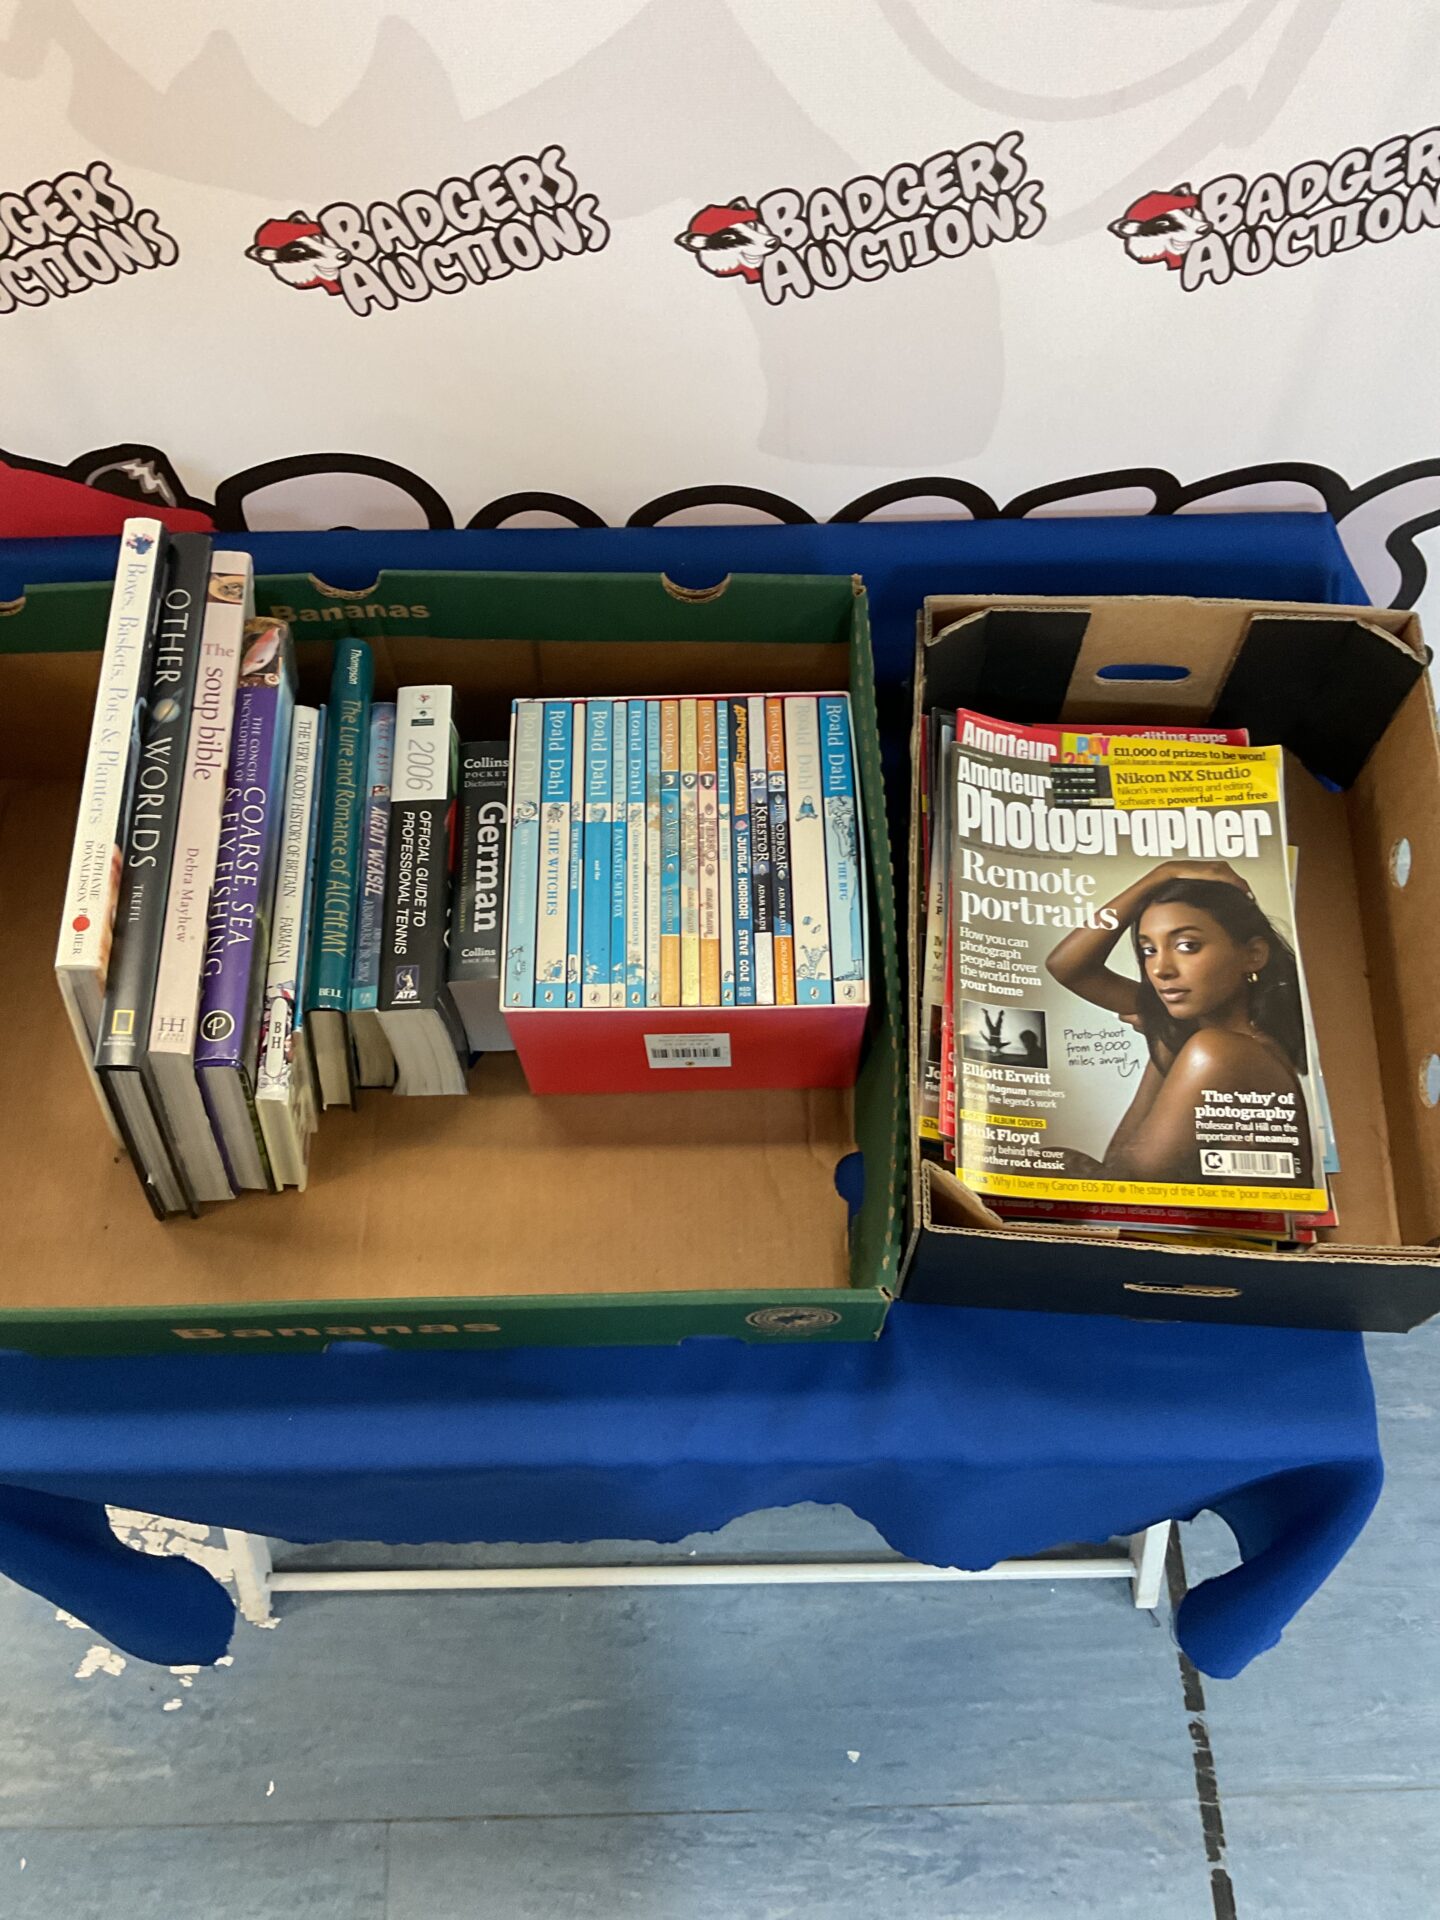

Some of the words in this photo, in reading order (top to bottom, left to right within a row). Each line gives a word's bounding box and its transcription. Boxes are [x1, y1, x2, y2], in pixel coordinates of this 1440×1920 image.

[757, 131, 1027, 249] BADGERS
[1199, 126, 1440, 236] BADGER
[0, 161, 133, 252] GERS
[319, 145, 577, 262] BADGERS
[760, 180, 1046, 305] AUCTIONS
[1181, 181, 1440, 292] AUCTION
[0, 209, 178, 313] CTIONS
[339, 194, 609, 316] AUCTIONS
[118, 563, 147, 610] Boxes,
[270, 603, 431, 622] Bananas
[154, 589, 191, 686] OTHER
[203, 643, 235, 658] The
[347, 649, 362, 685] Thompson
[194, 667, 223, 720] soup
[342, 700, 361, 723] The
[235, 694, 253, 767] ENCYCLOPEDIA
[252, 717, 263, 734] THE
[299, 721, 311, 739] THE
[339, 725, 359, 755] Lure
[549, 711, 566, 751] Roald
[591, 711, 608, 752] Roald
[631, 711, 641, 751] Roald
[798, 705, 811, 746] Roald
[826, 704, 844, 747] Roald
[962, 721, 1057, 762] Amateur
[192, 727, 225, 780] bible
[246, 739, 260, 781] CONCISE
[296, 742, 310, 764] VERY
[405, 739, 435, 791] 2006
[464, 757, 509, 769] Collins
[1114, 747, 1157, 758] £11,000
[1159, 747, 1171, 758] of
[1172, 748, 1208, 760] prizes
[1209, 749, 1220, 758] to
[1221, 749, 1235, 760] be
[1237, 751, 1266, 761] won!
[90, 750, 119, 824] Planters
[292, 766, 308, 803] BLOODY
[336, 759, 356, 787] and
[464, 780, 507, 788] Dictionary
[548, 760, 564, 795] Dahl
[590, 760, 607, 796] Dahl
[631, 760, 641, 795] Dahl
[665, 775, 674, 785] 3
[685, 775, 694, 786] 9
[704, 774, 711, 785] 1
[750, 772, 766, 782] 39
[769, 776, 784, 786] 48
[798, 754, 813, 790] Dahl
[828, 754, 846, 791] Dahl
[958, 756, 1054, 797] Amateur
[1116, 771, 1166, 785] Nikon
[1169, 771, 1192, 783] NX
[1196, 767, 1251, 782] Studio
[1150, 786, 1167, 794] new
[1168, 783, 1203, 795] viewing
[1205, 782, 1221, 792] and
[1223, 780, 1253, 793] editing
[129, 737, 173, 868] WORLDS
[224, 788, 242, 801] &
[1119, 796, 1156, 806] software
[1167, 793, 1213, 806] powerful
[1225, 793, 1243, 802] and
[1246, 790, 1268, 800] free
[220, 813, 239, 851] FLY
[289, 804, 304, 844] HISTORY
[331, 790, 355, 855] Romance
[369, 806, 387, 846] AGENT
[957, 781, 1272, 858] Photographer
[233, 787, 266, 891] COARSE,
[287, 846, 300, 857] OF
[417, 811, 432, 865] OFFICIAL
[549, 829, 560, 857] THE
[614, 829, 623, 881] FANTASTIC
[737, 837, 748, 873] JUNGLE
[183, 848, 199, 884] Debra
[330, 858, 350, 876] of
[365, 849, 385, 897] WEASEL
[397, 812, 415, 905] PROFESSIONAL
[474, 801, 507, 932] German
[960, 848, 1096, 896] Remote
[284, 858, 299, 897] BRITAIN
[414, 868, 429, 907] GUIDE
[546, 859, 558, 916] WITCHES
[175, 890, 194, 943] Mayhew
[738, 878, 749, 919] HORROR!
[960, 891, 1119, 931] portraits
[204, 862, 233, 976] FISHING
[227, 901, 254, 946] SEA
[320, 880, 350, 958] ALCHEMY
[394, 909, 409, 954] TENNIS
[413, 909, 426, 927] TO
[279, 917, 293, 958] FARMAN
[461, 949, 496, 957] Collins
[738, 930, 748, 956] STEVE
[960, 926, 984, 941] How
[985, 932, 1006, 945] you
[1007, 938, 1029, 948] can
[960, 941, 1022, 960] photograph
[739, 960, 749, 982] COLE
[960, 954, 995, 968] people
[996, 960, 1010, 970] all
[1011, 963, 1038, 973] over
[960, 965, 978, 976] the
[979, 969, 1010, 983] world
[1011, 973, 1042, 986] from
[318, 988, 343, 998] BELL
[395, 990, 417, 999] ATP
[960, 978, 987, 993] your
[989, 982, 1023, 996] home
[1067, 1042, 1090, 1057] from
[1094, 1040, 1132, 1054] 8,000
[1069, 1056, 1094, 1066] miles
[962, 1062, 1003, 1081] Elliott
[1005, 1071, 1051, 1085] Erwitt
[987, 1083, 1027, 1096] Magnum
[1029, 1088, 1066, 1098] members
[989, 1095, 1002, 1104] the
[1003, 1097, 1035, 1107] legend's
[1036, 1100, 1057, 1108] work
[1195, 1105, 1296, 1121] photography
[1201, 1090, 1233, 1103] The
[1278, 1092, 1295, 1105] of
[994, 1116, 1016, 1125] ALBUM
[1018, 1119, 1044, 1128] COVERS
[997, 1129, 1041, 1146] Floyd
[1196, 1121, 1234, 1130] Professor
[1235, 1122, 1253, 1131] Paul
[1255, 1122, 1269, 1131] Hill
[1284, 1123, 1298, 1132] the
[1196, 1132, 1243, 1142] importance
[1244, 1132, 1253, 1142] of
[1255, 1134, 1299, 1145] meaning
[998, 1145, 1025, 1156] behind
[1027, 1147, 1041, 1157] the
[1042, 1151, 1064, 1159] cover
[1010, 1158, 1031, 1168] rock
[1033, 1160, 1065, 1170] classic
[1019, 1179, 1035, 1189] love
[1036, 1181, 1050, 1191] my
[1052, 1180, 1079, 1191] Canon
[1082, 1182, 1099, 1192] EOS
[1129, 1185, 1145, 1195] The
[1146, 1186, 1168, 1197] story
[170, 1323, 502, 1339] Bananas
